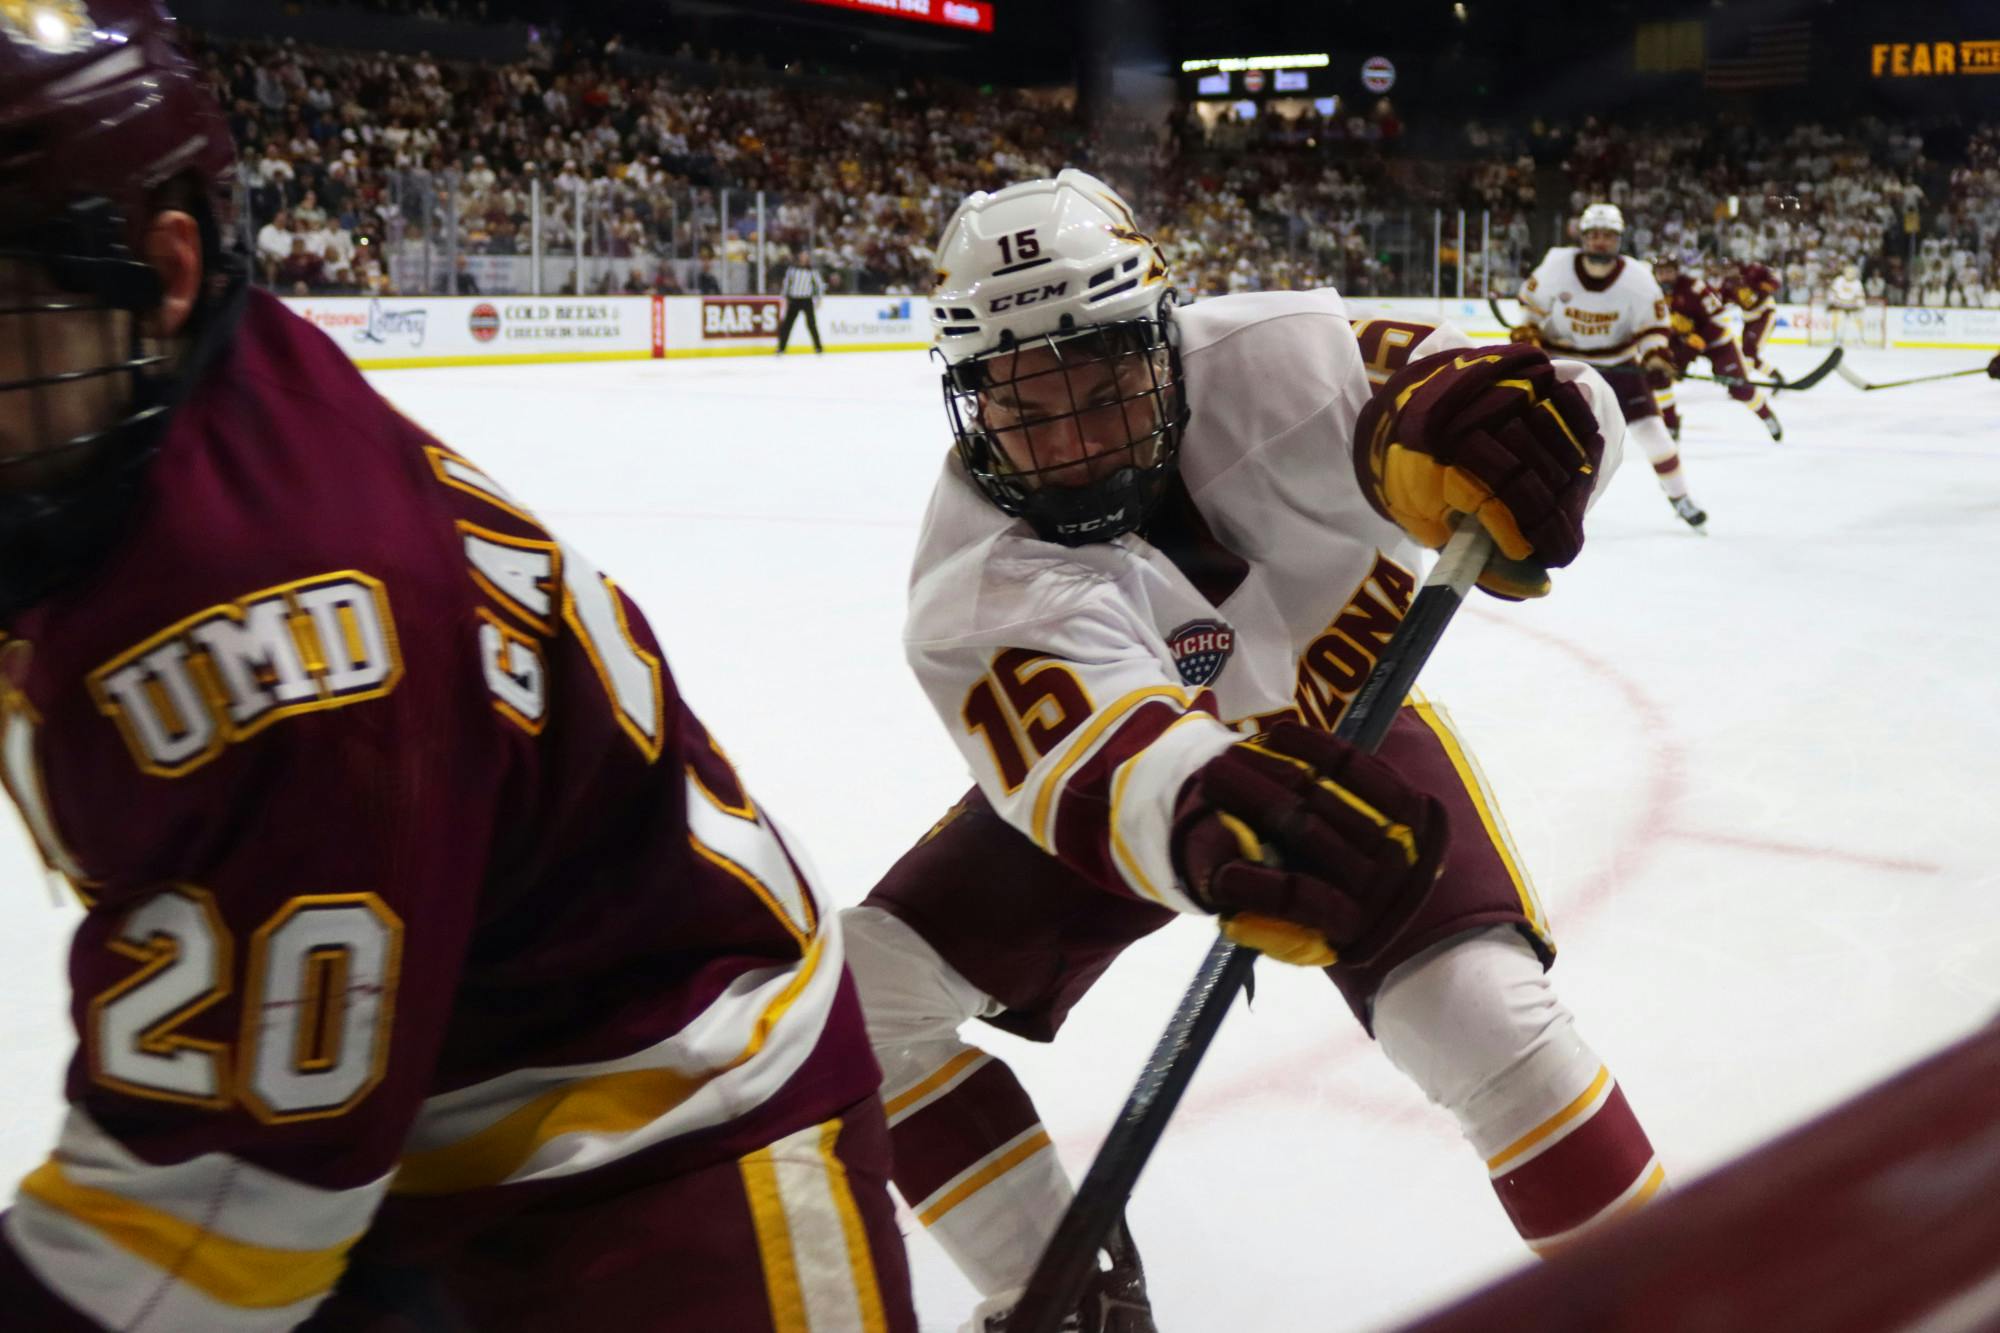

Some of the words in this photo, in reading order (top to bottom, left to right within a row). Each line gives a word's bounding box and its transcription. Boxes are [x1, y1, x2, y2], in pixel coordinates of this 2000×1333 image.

[1871, 42, 1956, 77] FEAR
[997, 229, 1040, 264] 15
[990, 281, 1067, 312] CCM
[705, 304, 778, 332] BAR-S
[1056, 507, 1126, 534] CCM
[86, 568, 405, 778] UMD
[961, 646, 1098, 797] 15
[87, 884, 405, 1126] 20
